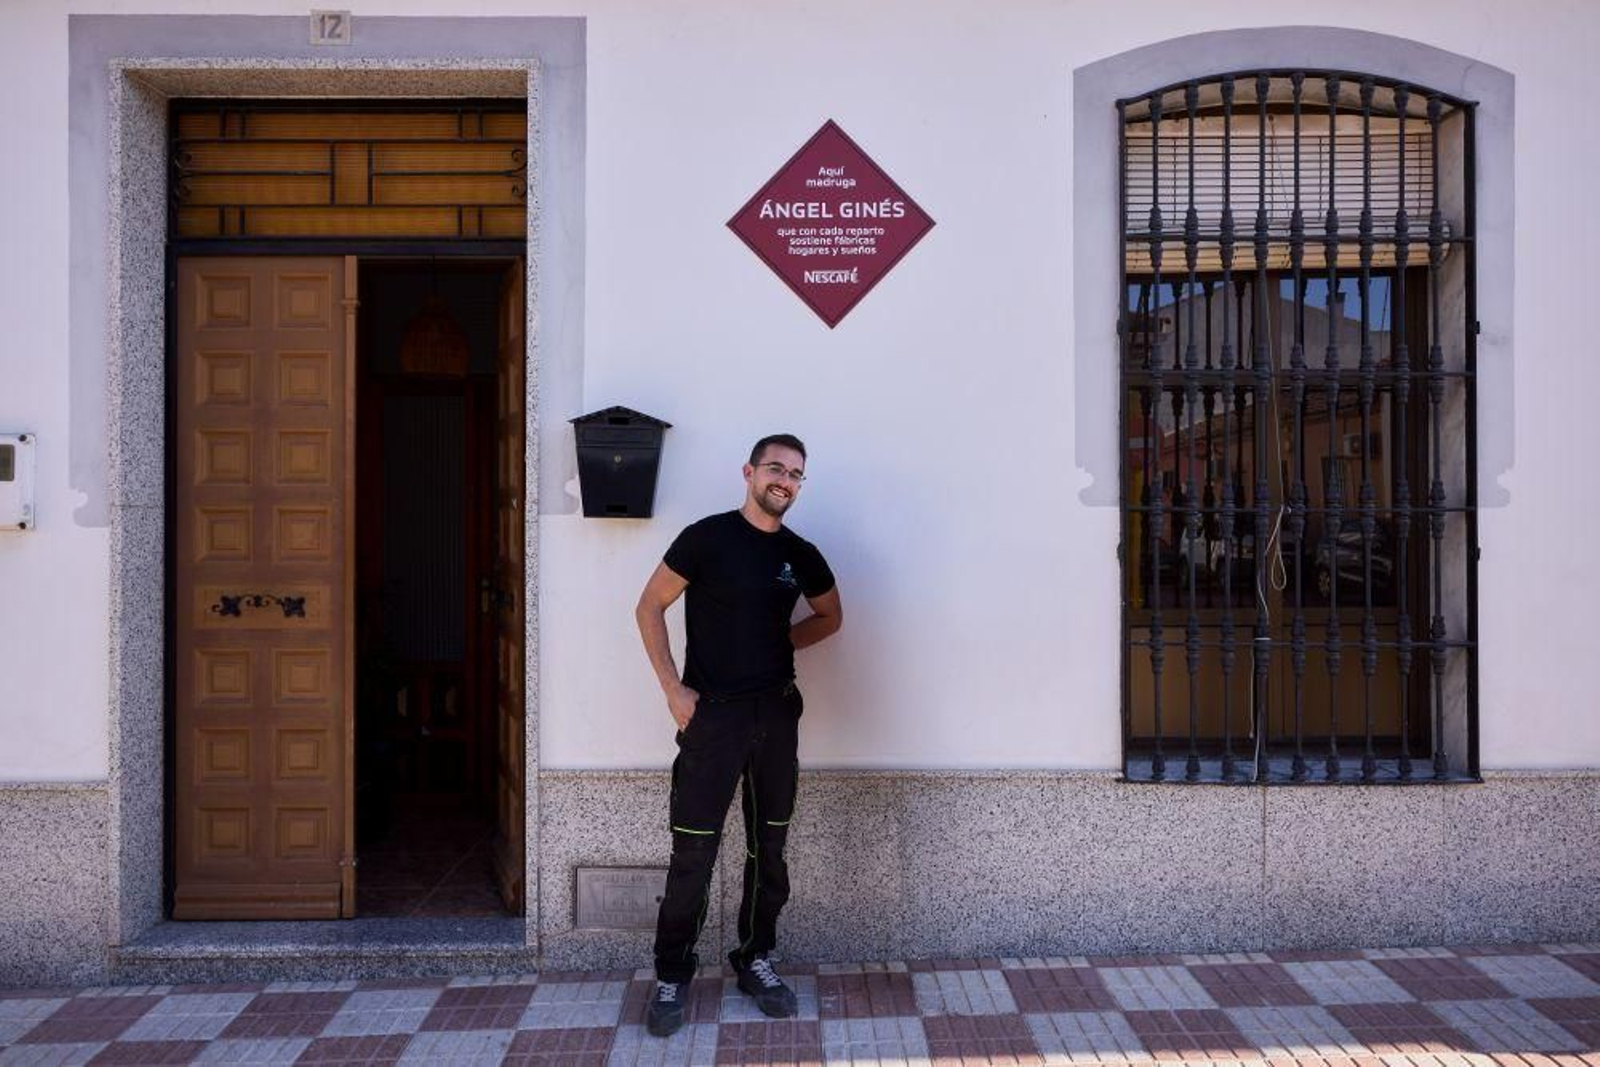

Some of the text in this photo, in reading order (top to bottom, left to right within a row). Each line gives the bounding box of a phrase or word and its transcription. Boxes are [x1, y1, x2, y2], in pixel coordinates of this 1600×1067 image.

[320, 14, 342, 38] 12
[818, 166, 845, 177] Aquí
[806, 178, 856, 188] madruga
[759, 198, 905, 218] ÁNGEL GINÉS
[777, 226, 885, 238] que con cada reparto
[789, 235, 876, 245] sostiene fábricas
[788, 244, 877, 256] hogares y sueños
[804, 267, 858, 283] NESCAFÉ
